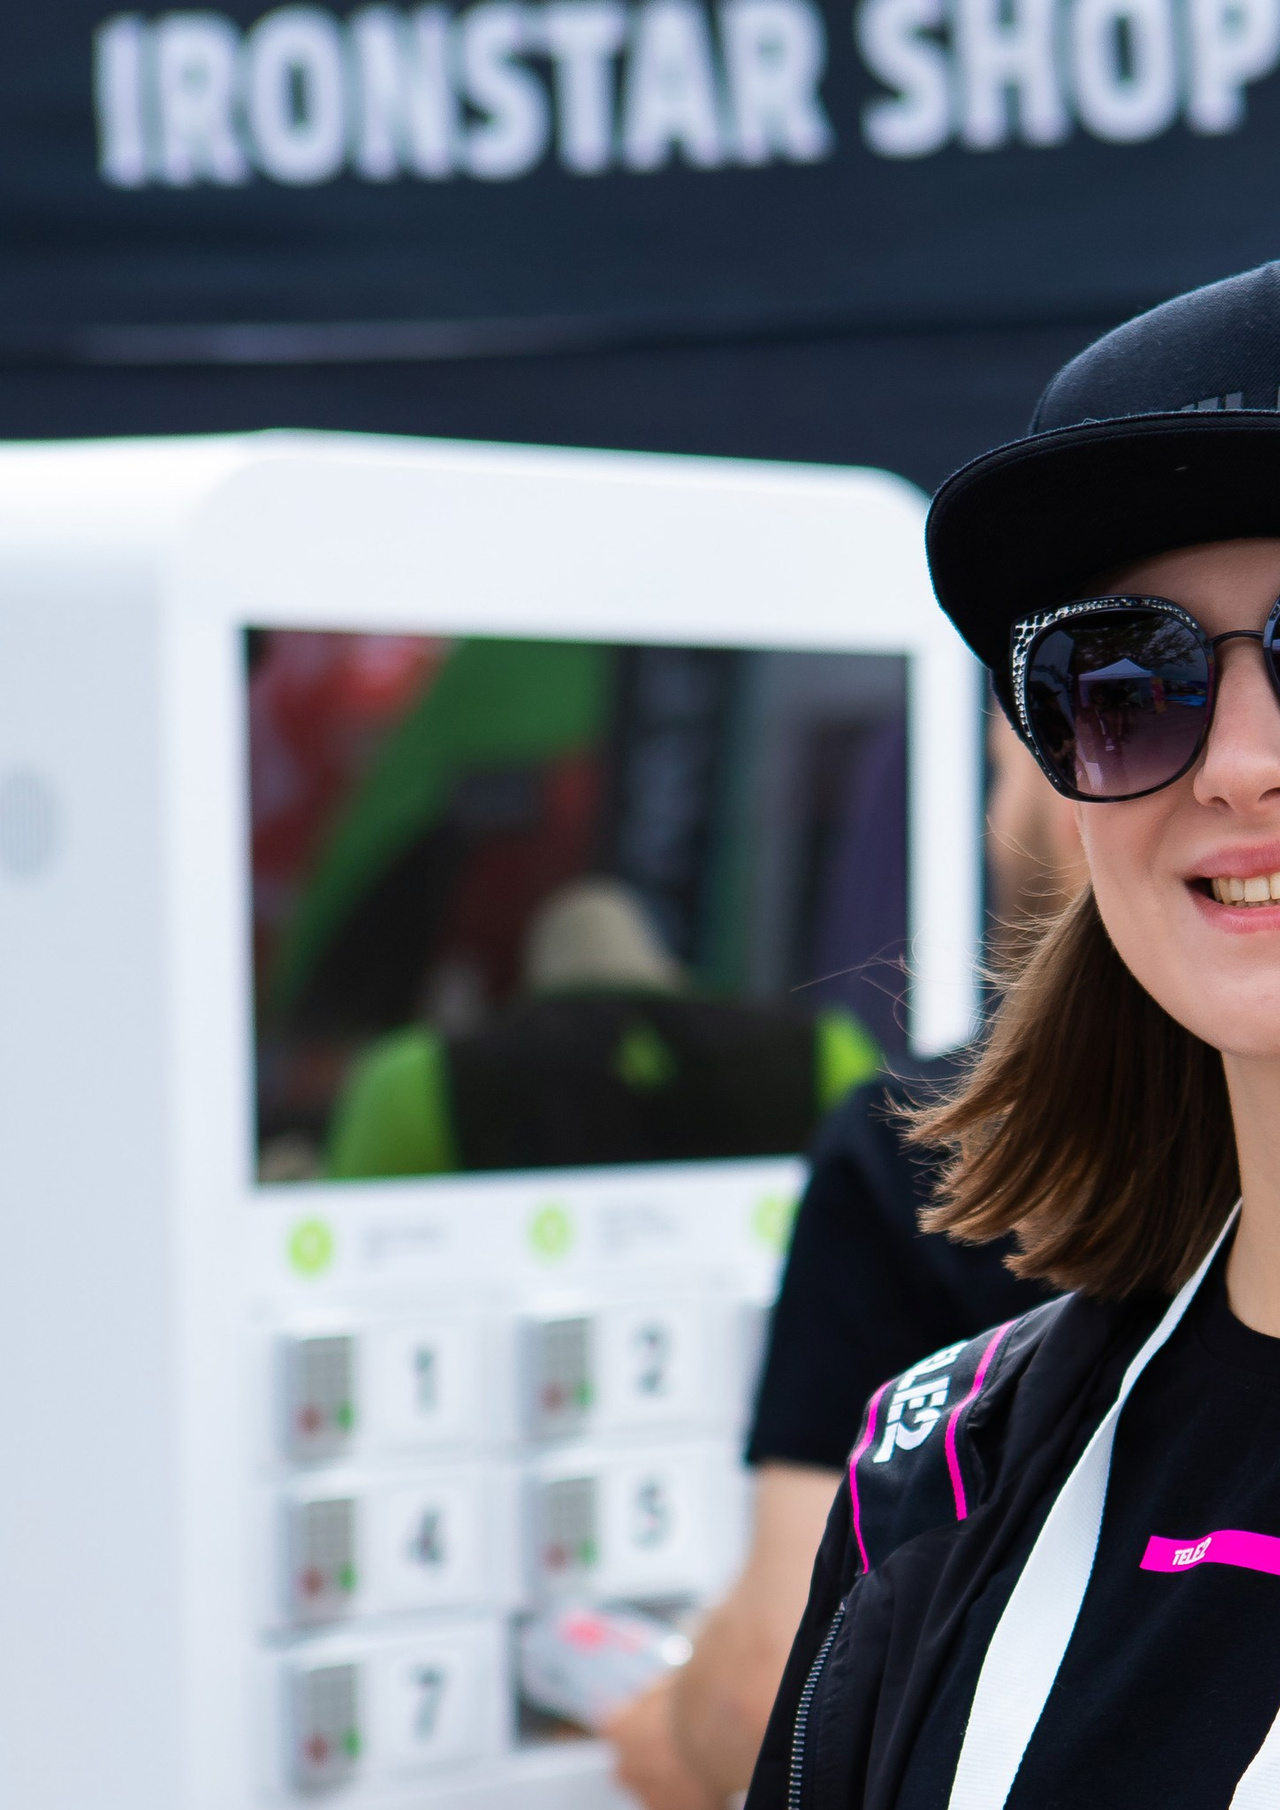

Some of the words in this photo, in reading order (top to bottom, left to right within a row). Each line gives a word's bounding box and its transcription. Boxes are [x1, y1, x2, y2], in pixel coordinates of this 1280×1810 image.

[95, 2, 832, 188] IRONSTAR
[410, 1344, 438, 1411] 1
[632, 1319, 672, 1396] 2
[1172, 1536, 1212, 1566] TELE2
[408, 1664, 446, 1742] 7
